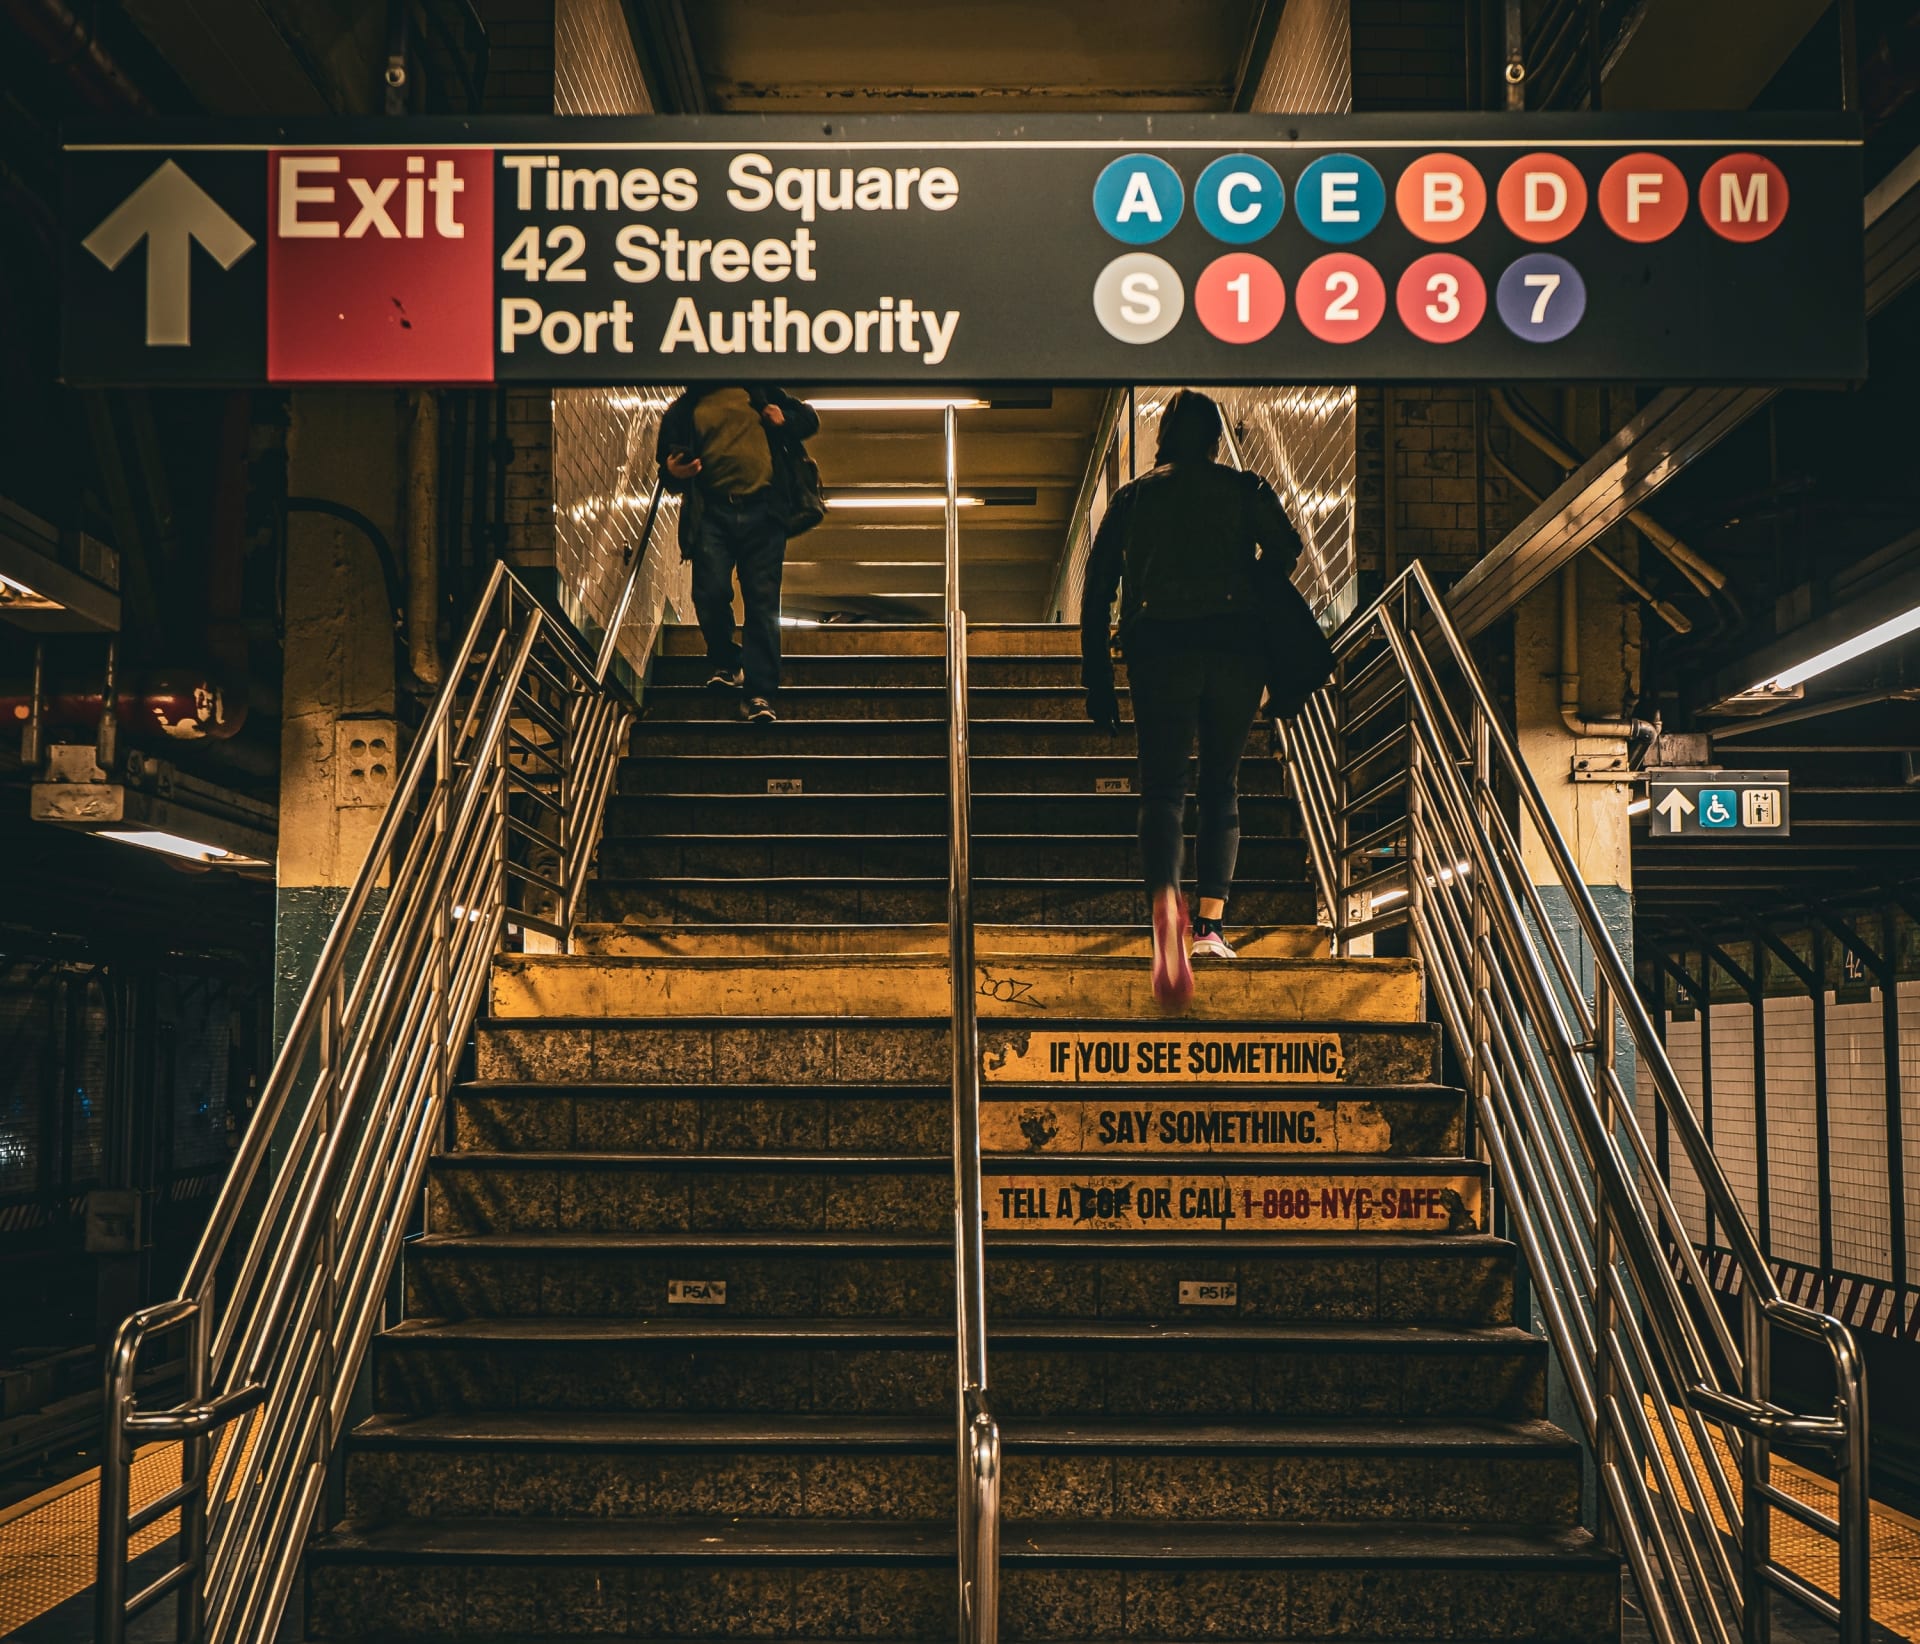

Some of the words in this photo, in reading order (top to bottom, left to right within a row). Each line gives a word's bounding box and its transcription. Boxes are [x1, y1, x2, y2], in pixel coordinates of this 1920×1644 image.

[278, 157, 464, 239] Exit
[503, 156, 698, 211] Times
[727, 154, 959, 222] Square
[1116, 172, 1162, 223] A
[1217, 172, 1262, 224] C
[1321, 172, 1360, 222] E
[1424, 173, 1465, 222] B
[1524, 173, 1567, 222] D
[1627, 173, 1663, 223] F
[1720, 173, 1769, 223] M
[502, 226, 586, 282] 42
[614, 225, 816, 283] Street
[1120, 273, 1161, 324] S
[1226, 273, 1250, 322] 1
[1325, 271, 1359, 320] 2
[1425, 273, 1460, 323] 3
[1524, 274, 1560, 323] 7
[501, 299, 633, 354] Port
[660, 297, 960, 365] Authority
[1051, 1042, 1070, 1072] IF
[1079, 1042, 1129, 1073] YOU
[1137, 1042, 1181, 1073] SEE
[1188, 1042, 1344, 1079] SOMETHING,
[1098, 1111, 1152, 1144] SAY
[1159, 1111, 1322, 1144] SOMETHING.
[999, 1188, 1050, 1218] TELL
[1056, 1188, 1073, 1218] A
[1137, 1188, 1172, 1218] OR
[1180, 1188, 1235, 1218] CALL
